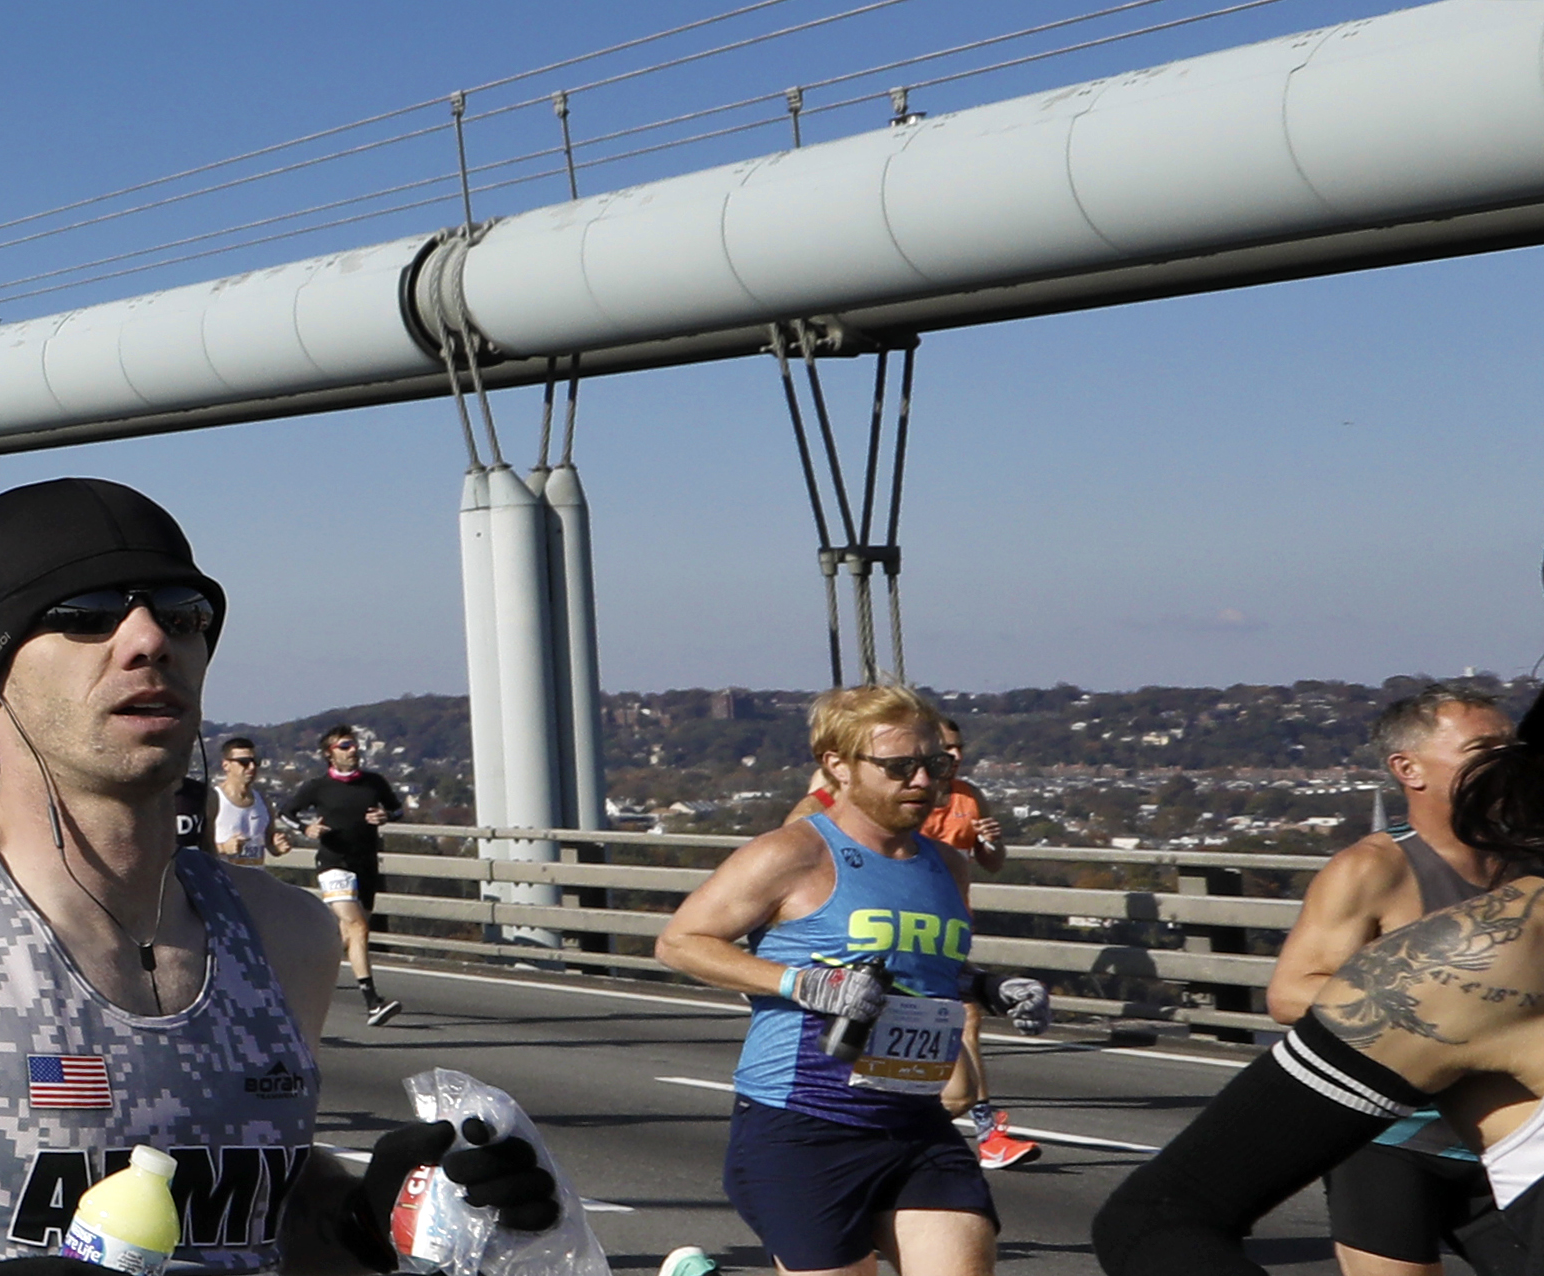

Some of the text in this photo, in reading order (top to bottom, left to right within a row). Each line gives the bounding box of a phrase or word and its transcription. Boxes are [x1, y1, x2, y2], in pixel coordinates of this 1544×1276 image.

[847, 908, 971, 962] SRC
[887, 1026, 942, 1060] 2724
[7, 1145, 311, 1247] AMY
